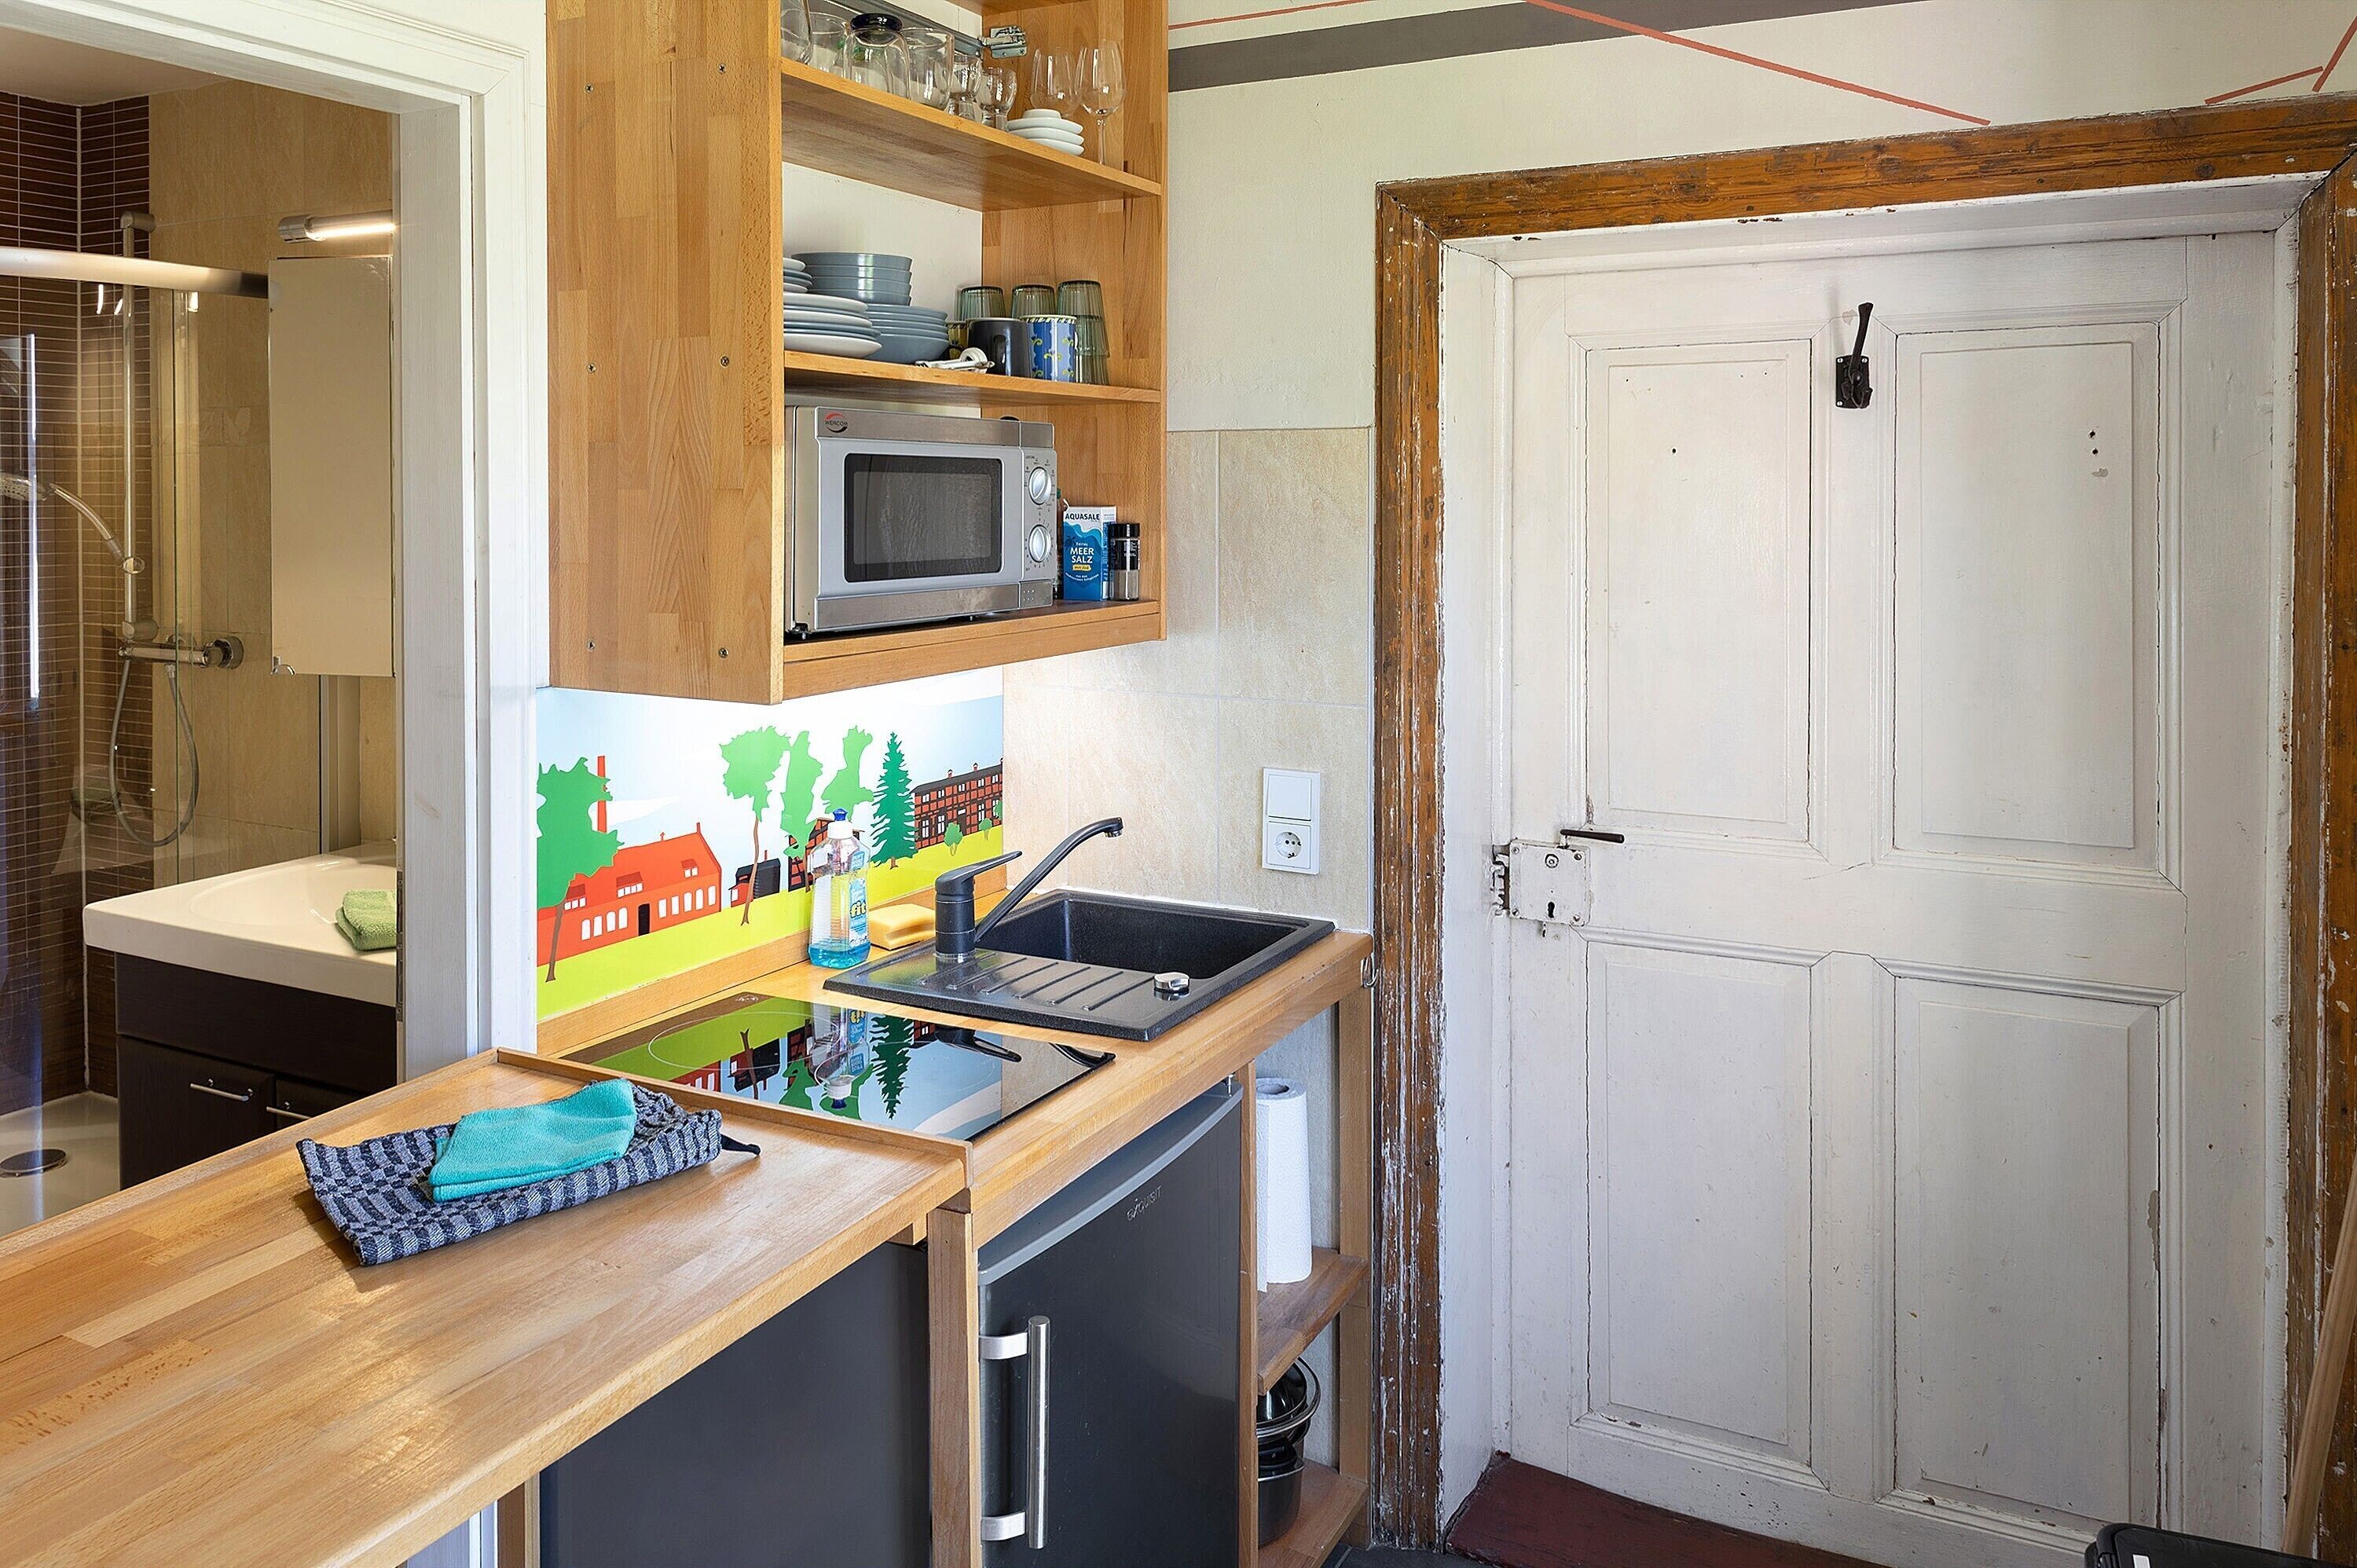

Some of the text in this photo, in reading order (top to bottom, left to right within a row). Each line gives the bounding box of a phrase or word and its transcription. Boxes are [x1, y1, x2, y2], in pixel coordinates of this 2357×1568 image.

[1070, 547, 1094, 555] MEER
[1071, 555, 1093, 563] SALZ
[849, 899, 867, 918] fit
